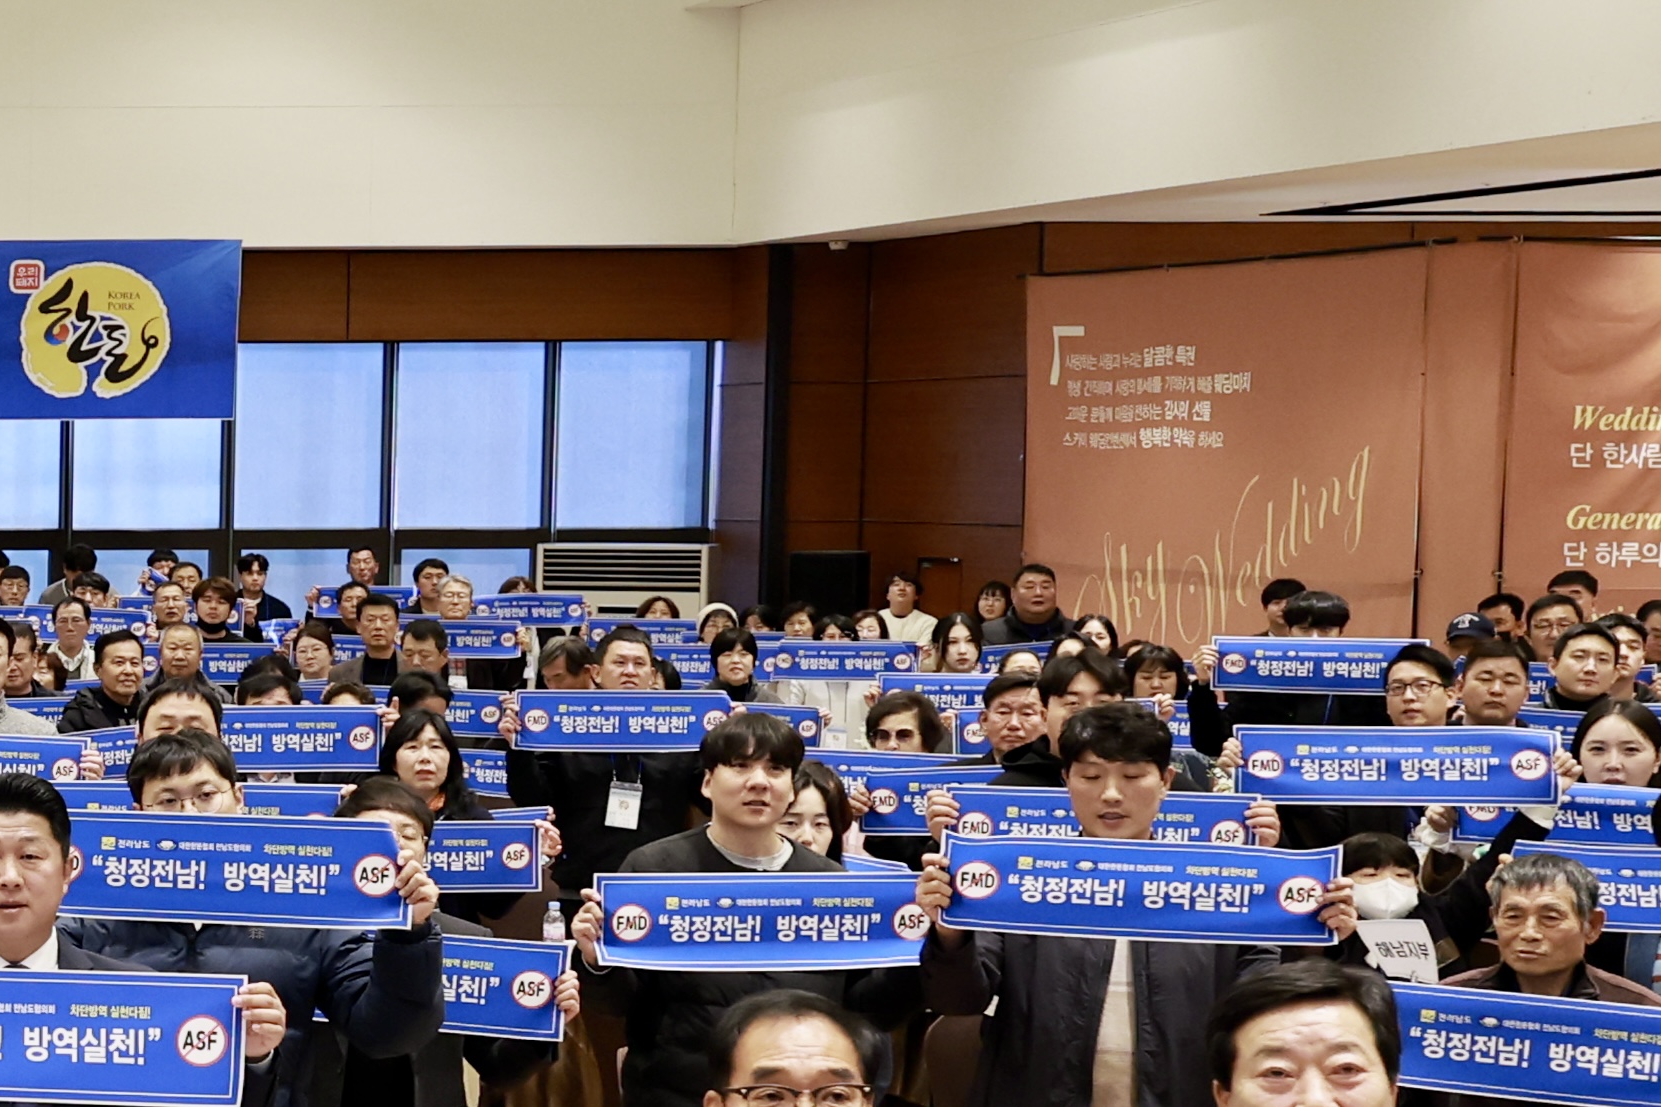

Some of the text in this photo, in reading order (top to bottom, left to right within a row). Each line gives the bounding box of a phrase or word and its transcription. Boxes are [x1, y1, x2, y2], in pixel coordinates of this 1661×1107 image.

[108, 291, 141, 301] KOREA
[108, 302, 136, 312] PORK
[1143, 345, 1173, 367] 달콤한
[1176, 345, 1196, 366] 특권
[1214, 372, 1251, 393] 웨딩마치
[1165, 401, 1189, 421] 감사의
[1193, 401, 1211, 421] 선물
[1573, 405, 1661, 431] Weddi
[1140, 427, 1171, 449] 행복한
[1570, 443, 1593, 468] 단
[1177, 445, 1370, 645] Wedding
[1563, 542, 1587, 567] 단
[528, 715, 547, 726] FMD
[352, 732, 371, 743] ASF
[56, 763, 76, 776] ASF
[1252, 757, 1279, 772] FMD
[1516, 758, 1542, 771] ASF
[872, 795, 895, 808] FMD
[962, 819, 991, 835] FMD
[118, 839, 332, 857] 전라남도 차단방역 실천다짐!
[506, 851, 526, 862] ASF
[1035, 858, 1068, 869] 전라남도
[359, 867, 390, 886] ASF
[961, 873, 995, 888] FMD
[1284, 888, 1316, 903] ASF
[617, 916, 647, 931] FMD
[898, 915, 925, 929] ASF
[1375, 940, 1429, 960] 해남지부
[517, 980, 547, 998] ASF
[14, 1004, 56, 1014] 전남도협의회
[70, 1003, 107, 1018] 차단방역
[110, 1005, 151, 1020] 실천다짐!
[183, 1030, 218, 1050] ASF
